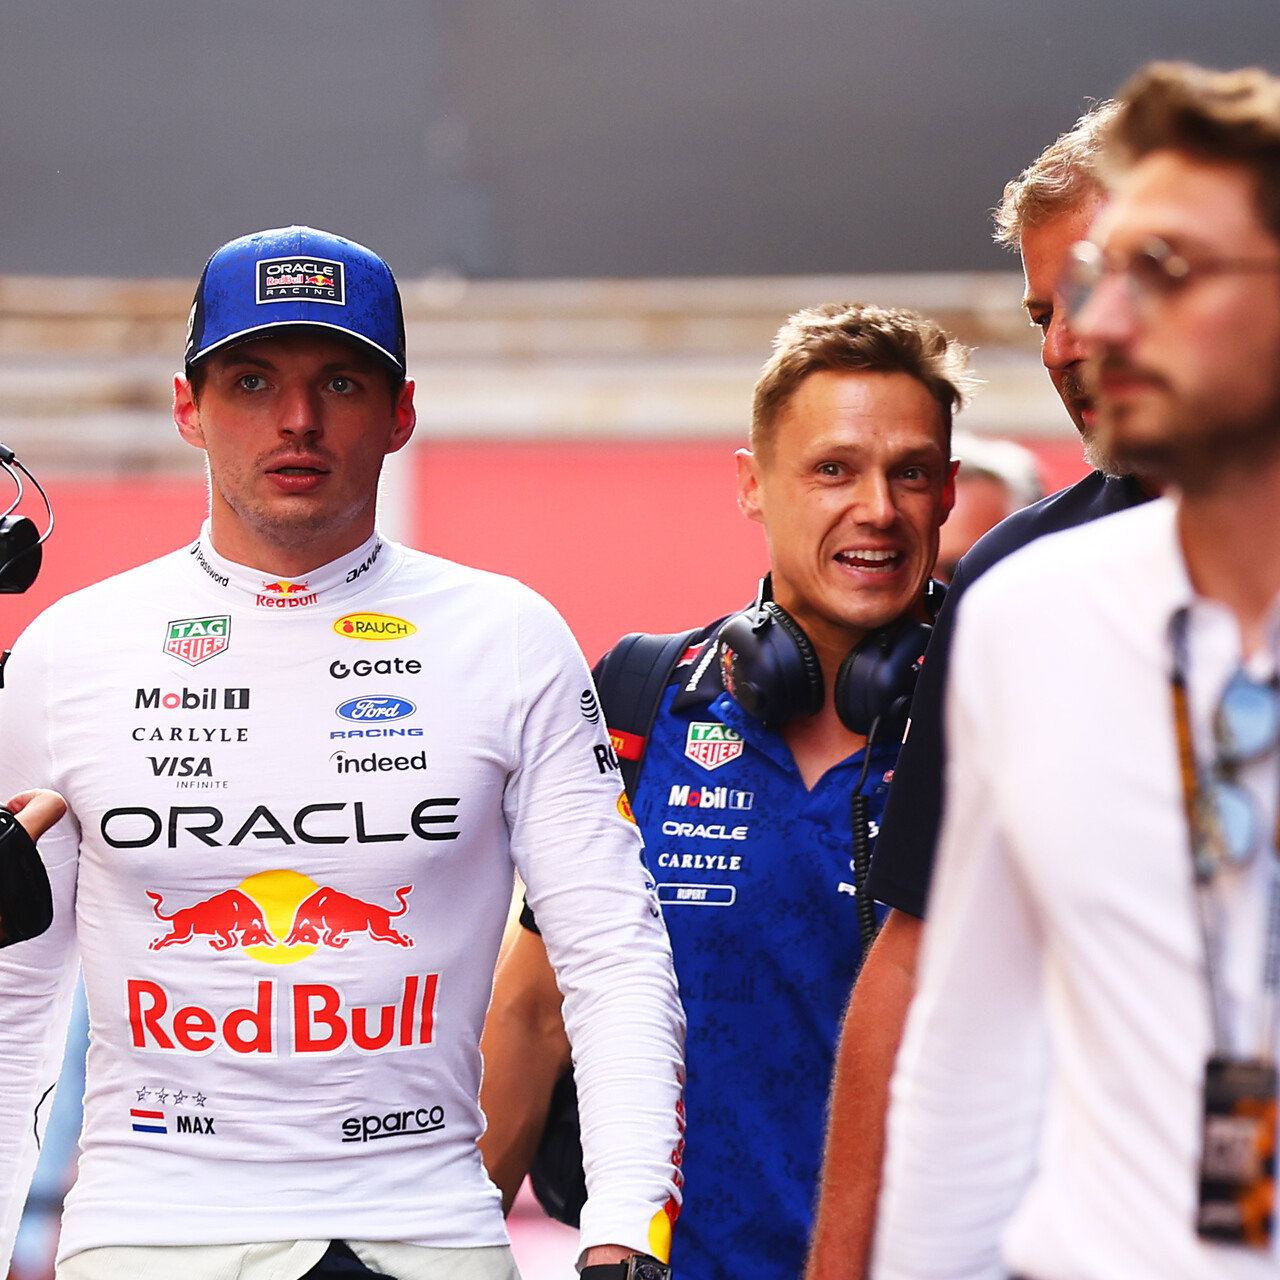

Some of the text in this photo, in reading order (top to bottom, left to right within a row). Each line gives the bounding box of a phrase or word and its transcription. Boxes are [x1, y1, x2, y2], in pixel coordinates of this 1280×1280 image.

[266, 263, 334, 276] ORACLE
[266, 288, 335, 297] RACING
[256, 592, 319, 608] Red Bull
[173, 620, 224, 637] TAG
[355, 620, 407, 635] RAUCH
[167, 637, 224, 660] HEUER
[353, 657, 422, 677] Gate
[135, 687, 217, 710] Mobil
[350, 700, 400, 719] Ford
[132, 727, 248, 742] CARLYLE
[329, 728, 424, 739] RACING
[694, 723, 741, 740] TAG
[336, 751, 427, 774] indeed
[688, 743, 742, 768] HEUER
[145, 756, 213, 777] VISA
[176, 781, 229, 789] INFINITE
[669, 785, 727, 809] Mobil
[100, 798, 460, 848] ORACLE
[662, 821, 748, 840] ORACLE
[658, 853, 741, 870] CARLYLE
[127, 973, 439, 1053] Red Bull
[176, 1116, 216, 1135] MAX
[341, 1105, 445, 1142] sparco
